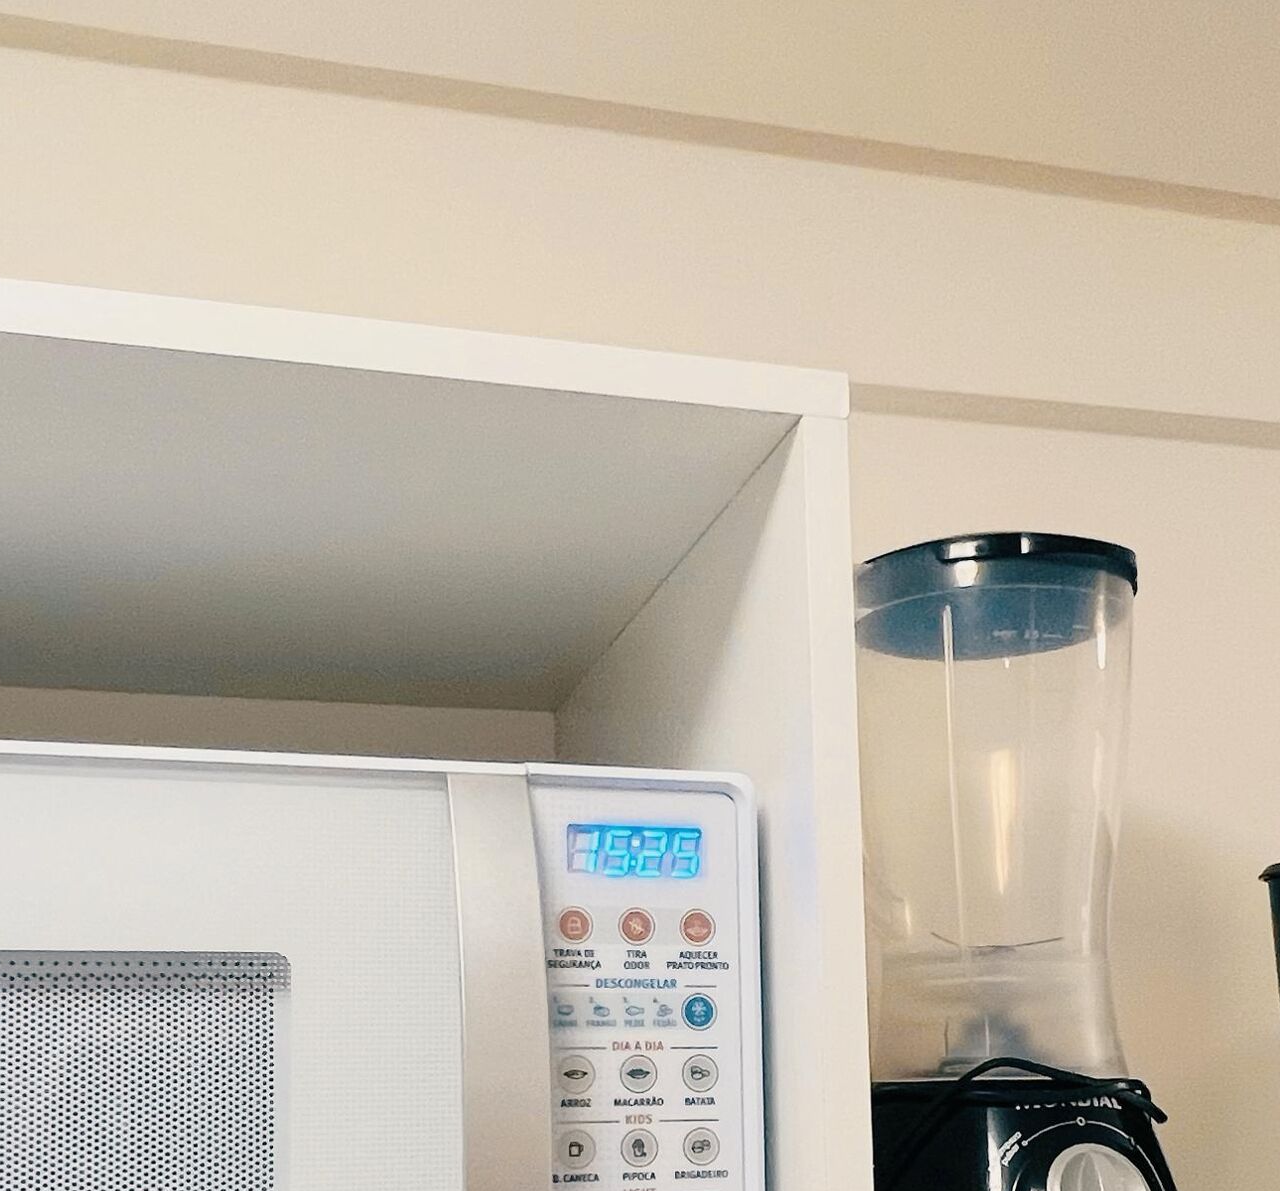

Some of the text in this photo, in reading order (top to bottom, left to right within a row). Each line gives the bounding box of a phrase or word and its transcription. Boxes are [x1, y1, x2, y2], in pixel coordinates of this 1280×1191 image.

[587, 829, 701, 879] 15:25
[626, 950, 647, 958] TIRA
[679, 951, 718, 959] AQUECER
[623, 961, 650, 970] ODOR
[595, 978, 678, 989] DESCONGELAR
[612, 1040, 664, 1051] DIA A DIA
[560, 1098, 592, 1108] ARROZ
[613, 1096, 664, 1107] MACARRÃO
[625, 1114, 653, 1124] KIDS
[563, 1173, 600, 1183] CANECA
[622, 1171, 656, 1181] PIPOCA
[674, 1169, 729, 1180] BRIGADEIRO
